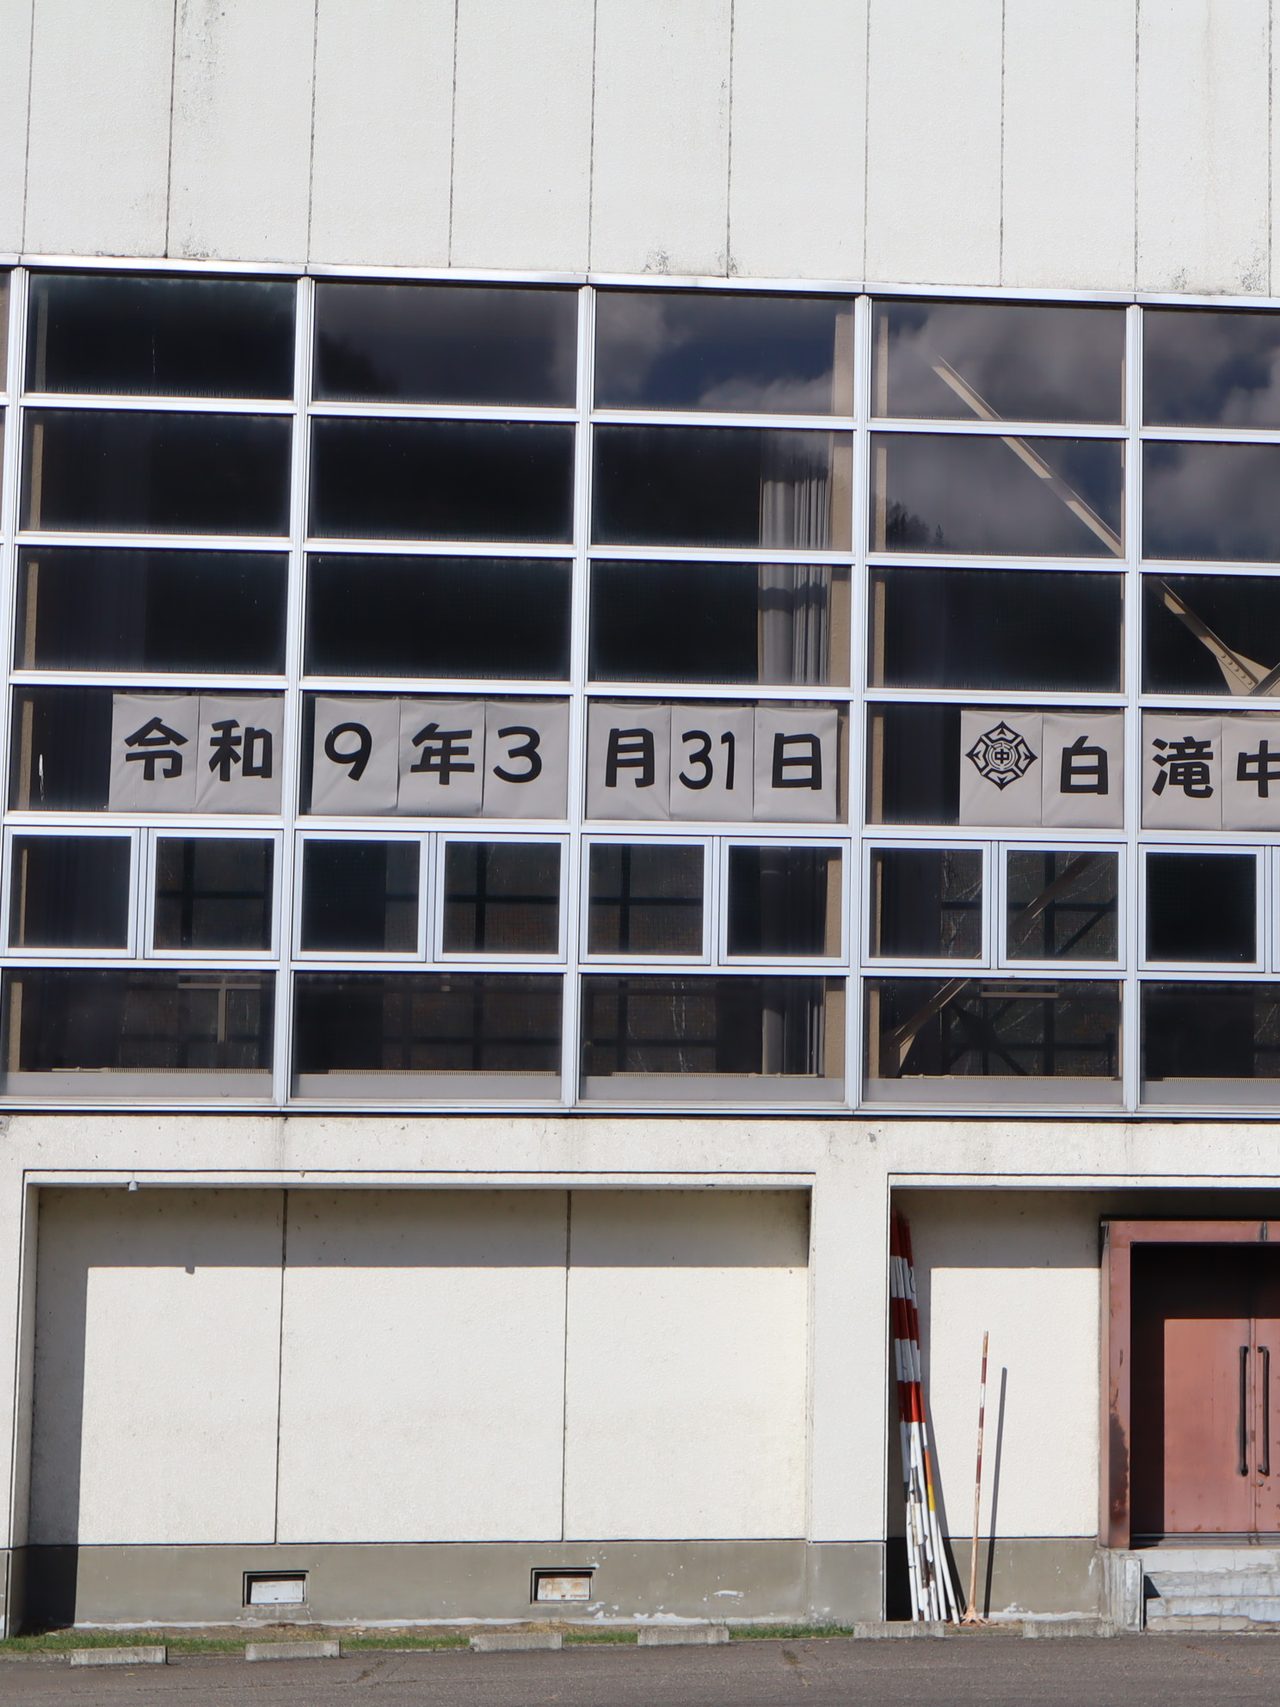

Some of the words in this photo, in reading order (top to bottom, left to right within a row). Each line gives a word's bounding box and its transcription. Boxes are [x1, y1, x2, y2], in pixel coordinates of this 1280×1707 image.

[124, 716, 823, 792] 令和9年3月31日
[994, 748, 1009, 764] 中
